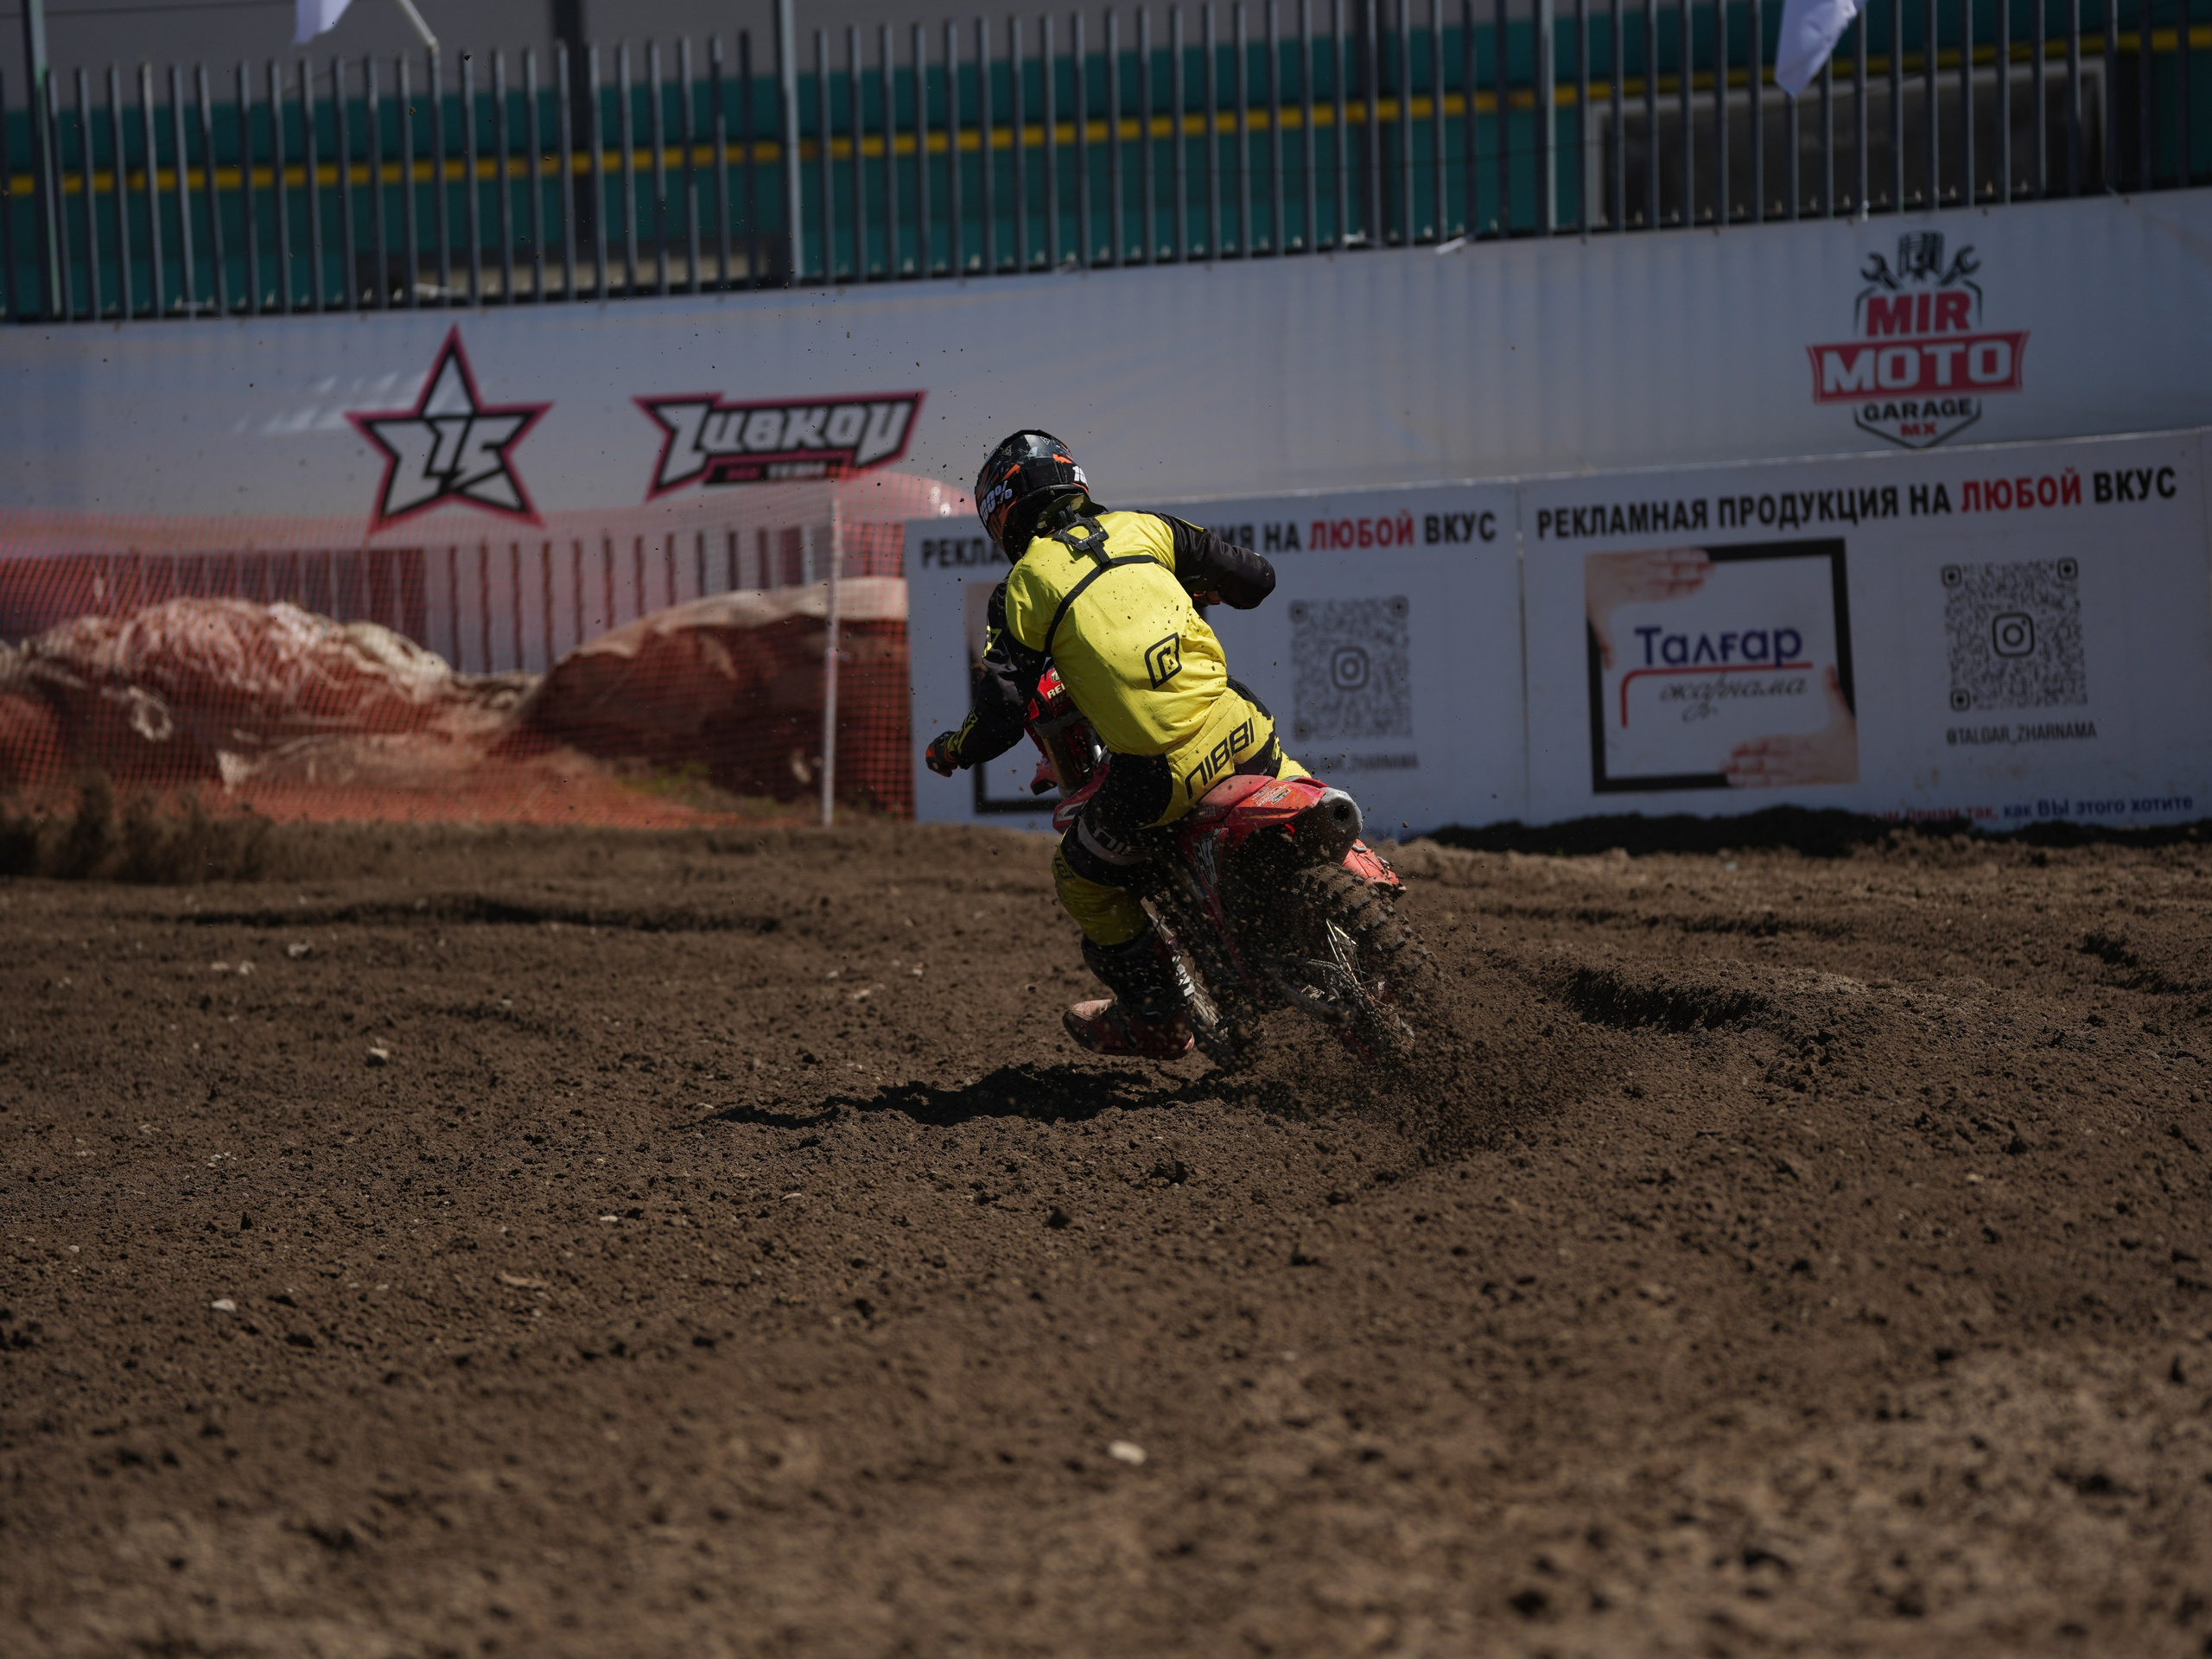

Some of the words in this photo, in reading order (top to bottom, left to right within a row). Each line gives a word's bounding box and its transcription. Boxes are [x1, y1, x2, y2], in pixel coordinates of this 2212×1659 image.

[1867, 290, 1971, 337] MIR
[1821, 338, 2013, 393] MOTO
[1863, 397, 1973, 422] GARAGE
[1901, 422, 1938, 437] MX
[1538, 499, 1709, 540] РЕКЛАМНАЯ
[1718, 486, 1900, 529] ПРОДУКЦИЯ
[1910, 482, 1952, 516] НА
[1961, 466, 2082, 512] ЛЮБОЙ
[2094, 466, 2177, 504] ВКУС
[1264, 522, 1302, 554] НА
[1309, 508, 1414, 551] ЛЮБОЙ
[1426, 510, 1497, 544] ВКУС
[1185, 717, 1255, 800] NIBBI
[2003, 804, 2032, 818] как
[2037, 798, 2069, 817] ВЫ
[2076, 800, 2126, 816] этого
[2131, 795, 2194, 813] хотите
